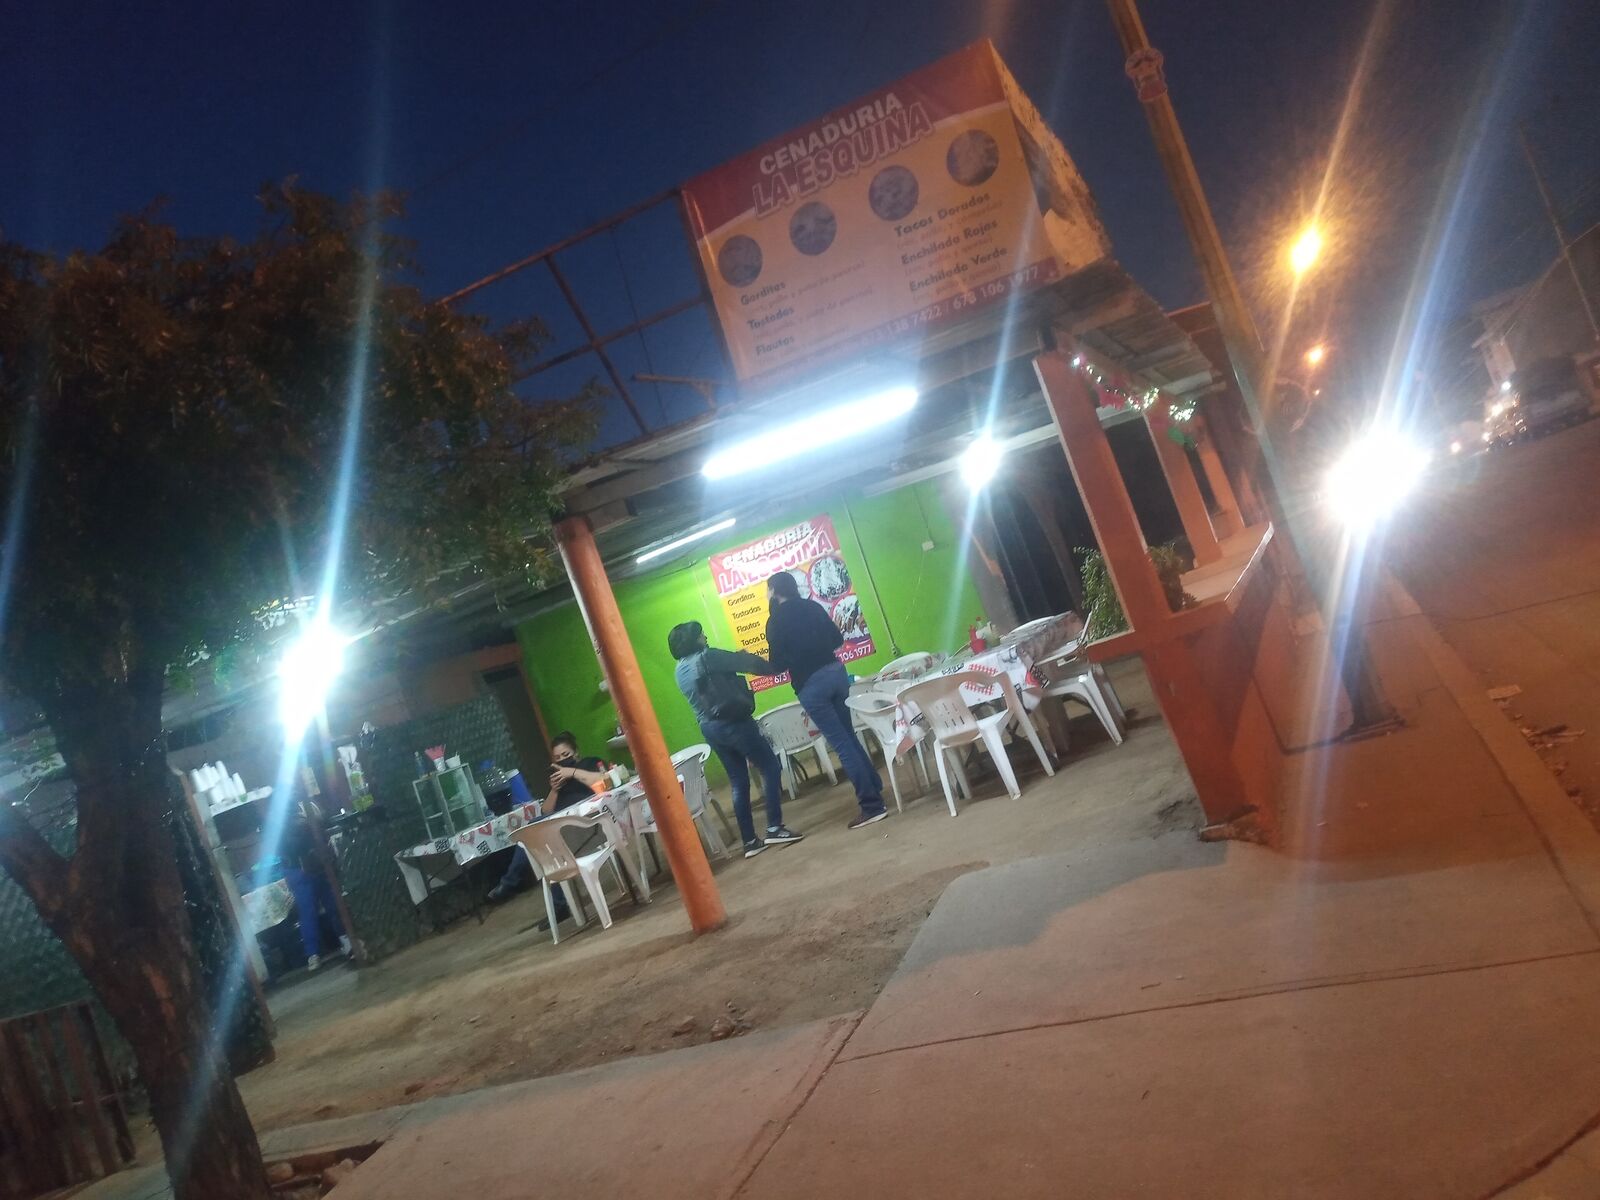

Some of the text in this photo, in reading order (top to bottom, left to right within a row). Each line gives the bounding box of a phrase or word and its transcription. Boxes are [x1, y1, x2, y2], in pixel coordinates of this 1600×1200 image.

[759, 92, 903, 175] CENADURIA
[752, 102, 935, 219] LA ESQUINA
[894, 216, 933, 237] Tacos
[718, 568, 746, 595] LA
[727, 592, 756, 607] Gorditas
[731, 604, 762, 620] Tostadas
[736, 620, 761, 634] Flautas
[741, 636, 761, 646] Tacos
[839, 650, 855, 663] 106
[854, 643, 871, 657] 1977
